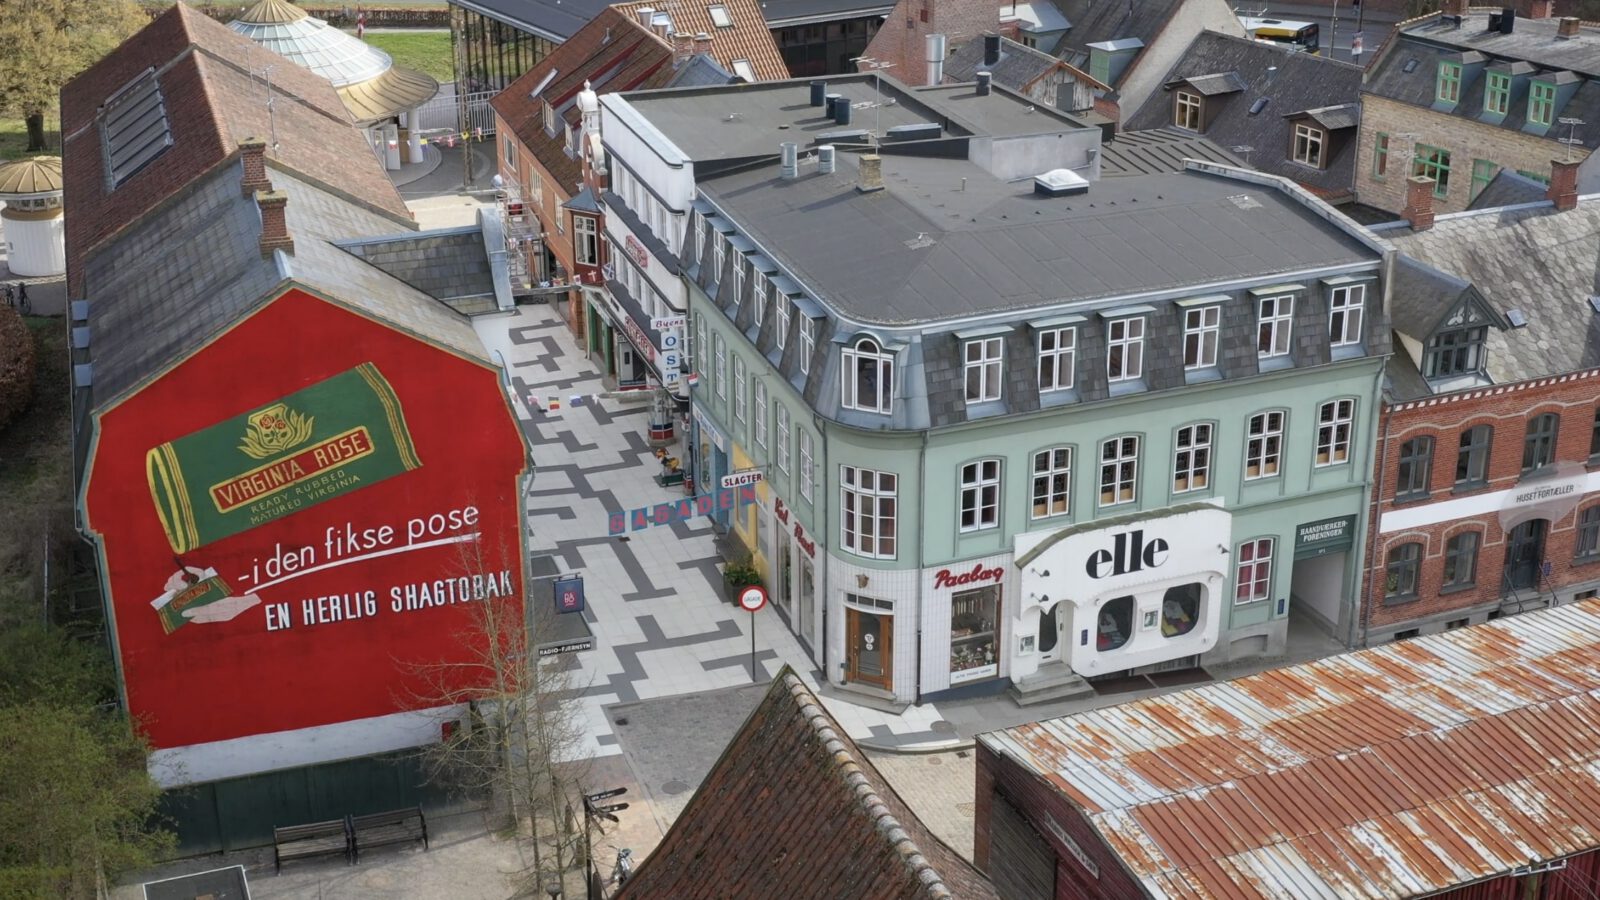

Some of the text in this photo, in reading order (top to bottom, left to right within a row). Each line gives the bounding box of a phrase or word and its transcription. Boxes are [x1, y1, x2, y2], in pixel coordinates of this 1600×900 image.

[218, 433, 366, 505] VIRGINIA ROSE
[251, 469, 345, 513] READY RUBBED
[725, 473, 762, 487] SLAGTER
[250, 474, 361, 525] MATURED VIRGINIA
[1516, 491, 1537, 503] HUSET
[324, 522, 394, 559] fikse
[407, 506, 479, 545] pose
[1085, 529, 1169, 579] elle
[1303, 529, 1343, 542] FORENINGEN
[264, 569, 514, 631] EN HERLIG SHAGTOBAK
[540, 643, 591, 655] RADIO-FJERNSYN
